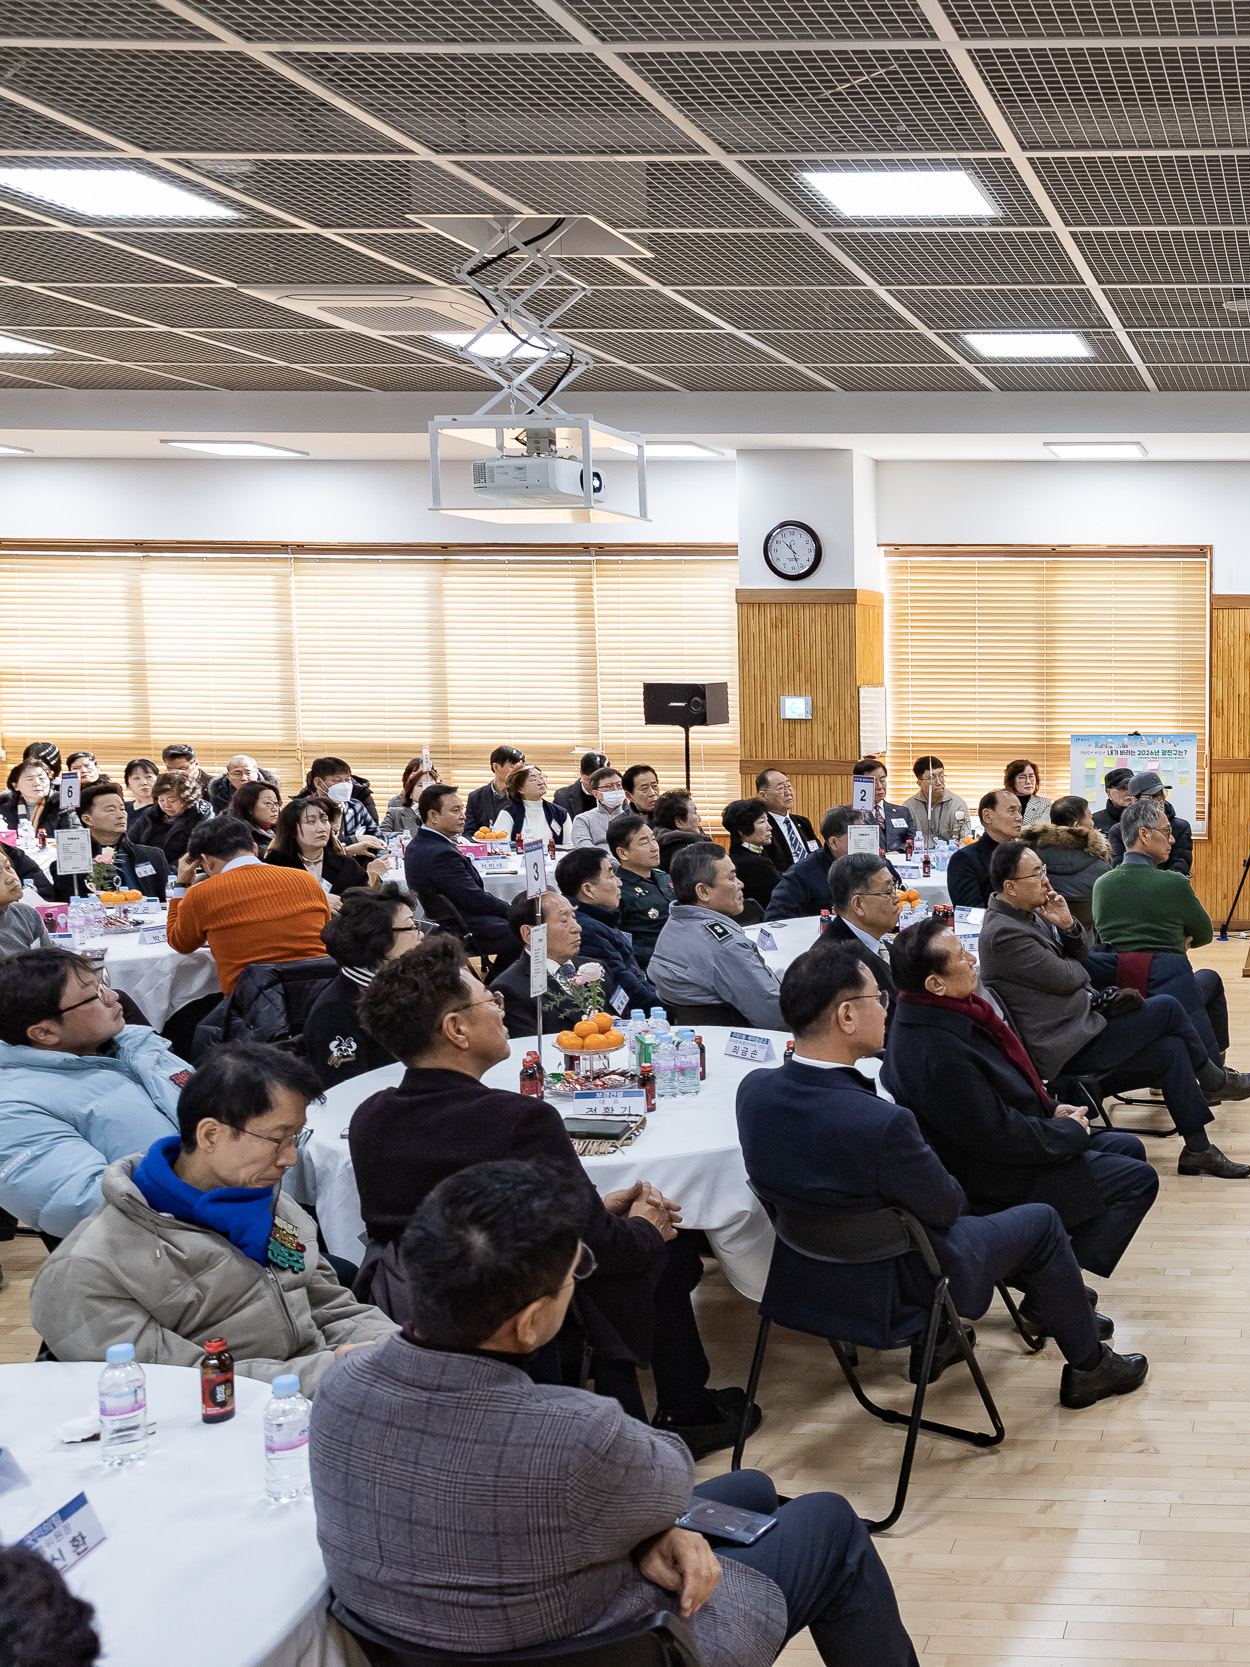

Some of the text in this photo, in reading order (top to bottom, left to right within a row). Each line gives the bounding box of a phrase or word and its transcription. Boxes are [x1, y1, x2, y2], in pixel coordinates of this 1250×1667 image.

[68, 786, 73, 798] 6
[860, 789, 867, 801] 2
[533, 862, 540, 882] 3
